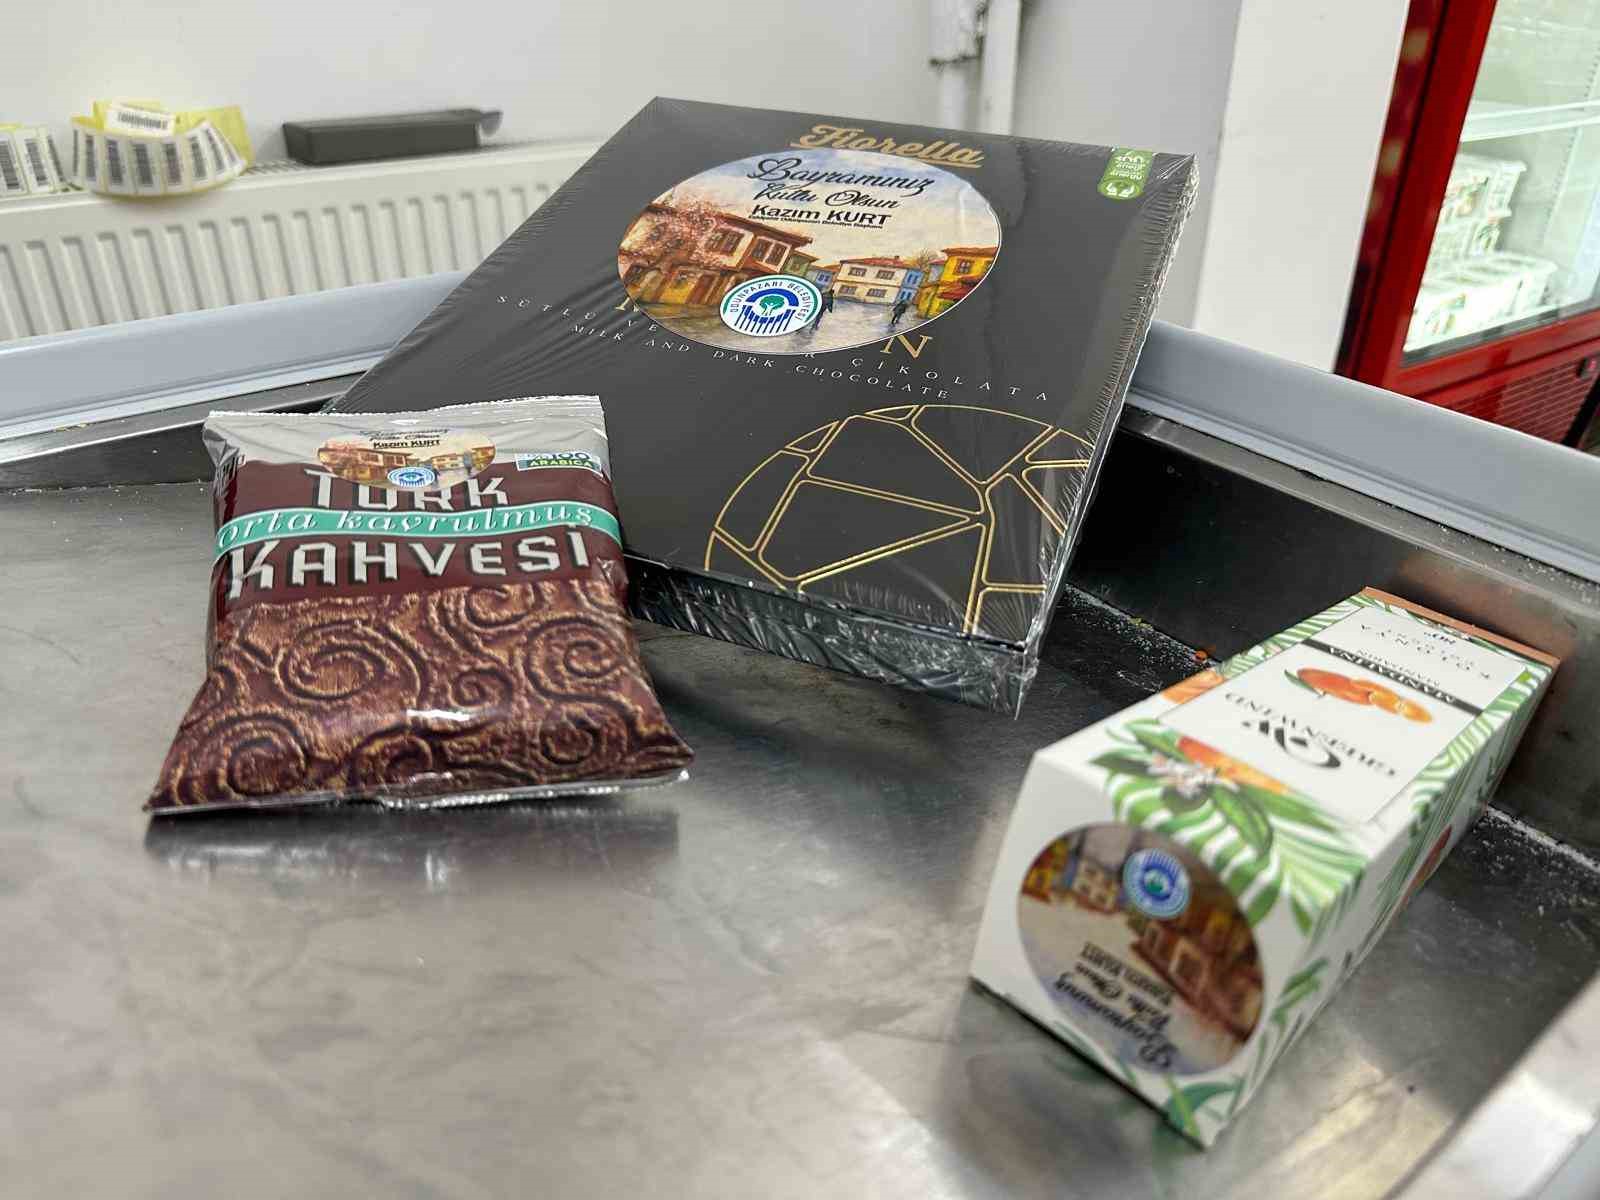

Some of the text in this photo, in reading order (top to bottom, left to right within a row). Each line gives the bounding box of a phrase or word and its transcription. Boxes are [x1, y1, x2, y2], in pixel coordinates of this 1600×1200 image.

[790, 124, 984, 168] Fiorella
[747, 158, 935, 198] Bayramınız
[751, 205, 821, 220] Kazım
[826, 210, 892, 225] KURT
[824, 189, 902, 209] Olsun
[645, 338, 690, 352] AND
[712, 350, 776, 369] DARK
[794, 364, 950, 400] CHOCOLATE
